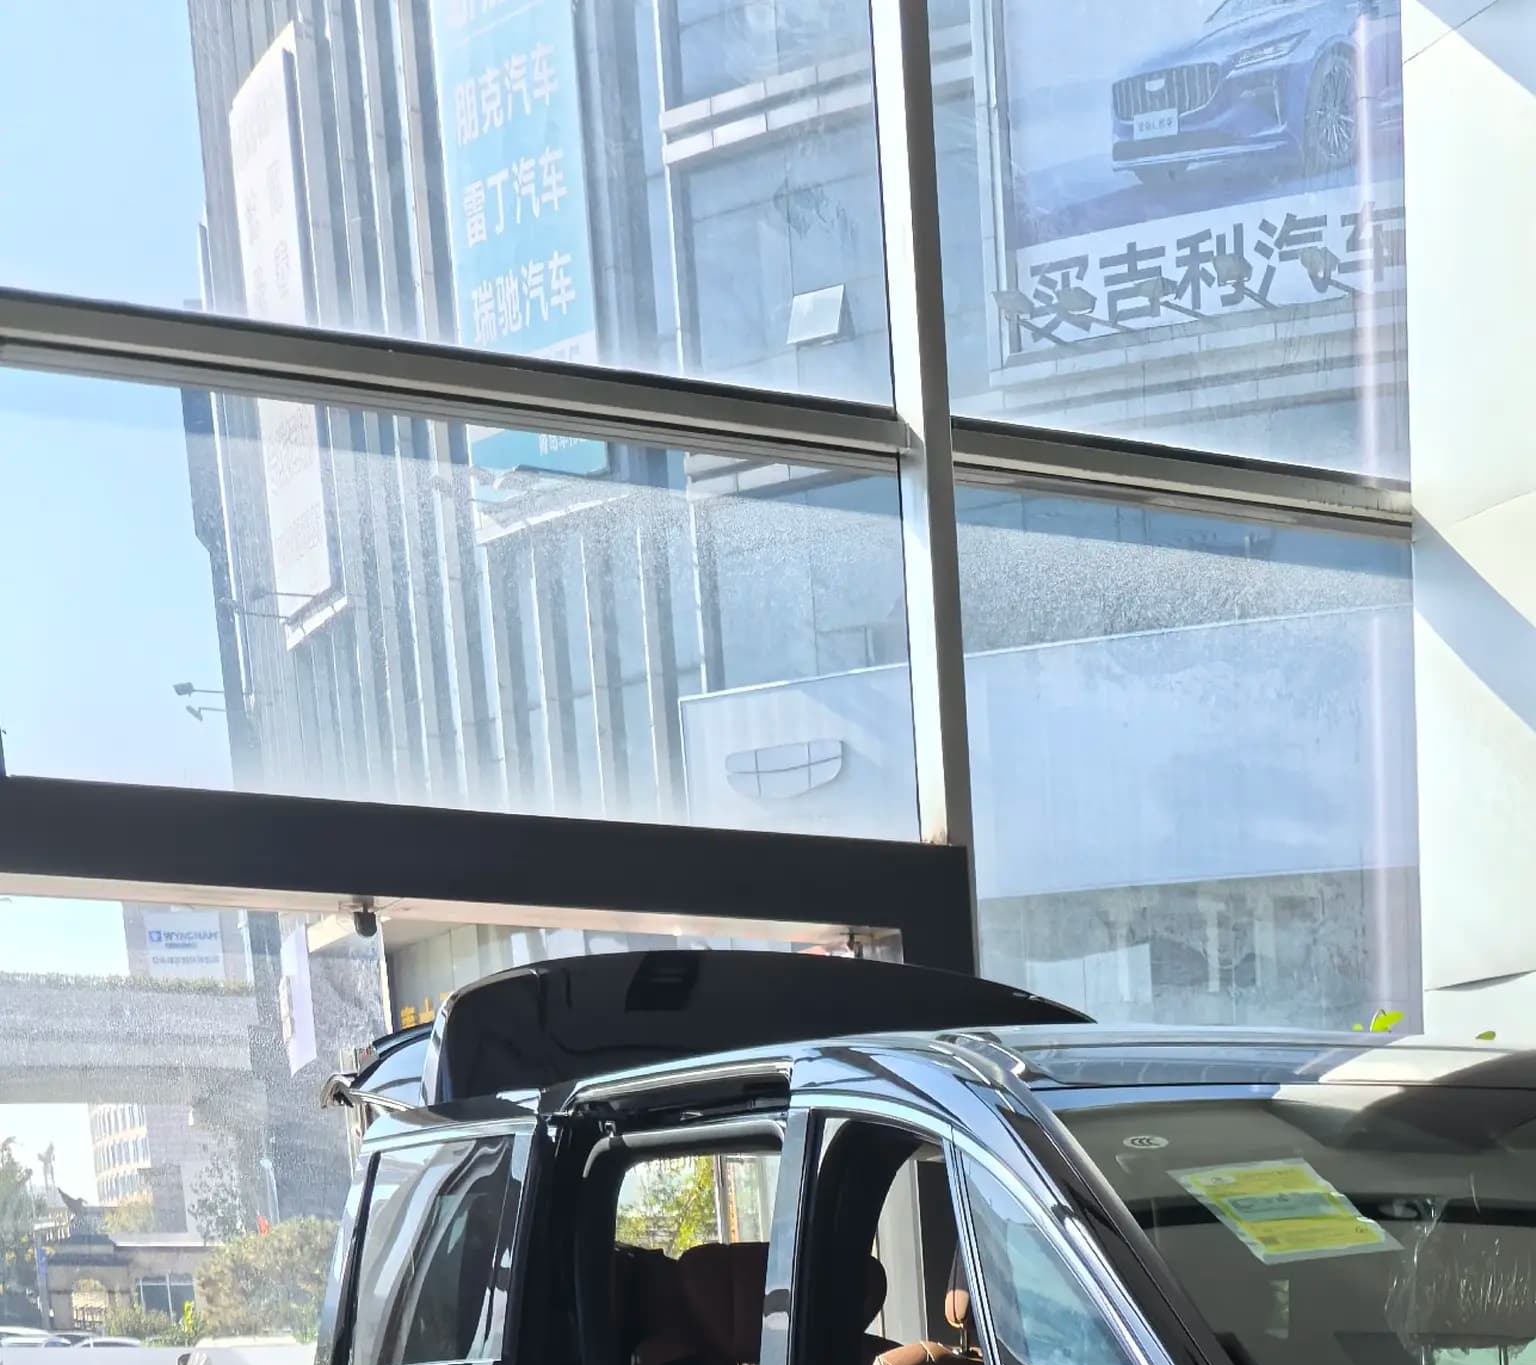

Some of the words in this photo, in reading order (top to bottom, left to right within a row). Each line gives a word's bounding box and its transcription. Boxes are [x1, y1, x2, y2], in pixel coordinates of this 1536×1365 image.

[455, 40, 559, 146] 朋克汽车
[463, 146, 568, 249] 雷丁汽车
[472, 250, 576, 347] 瑞驰汽车
[1026, 202, 1404, 334] 买吉利汽车
